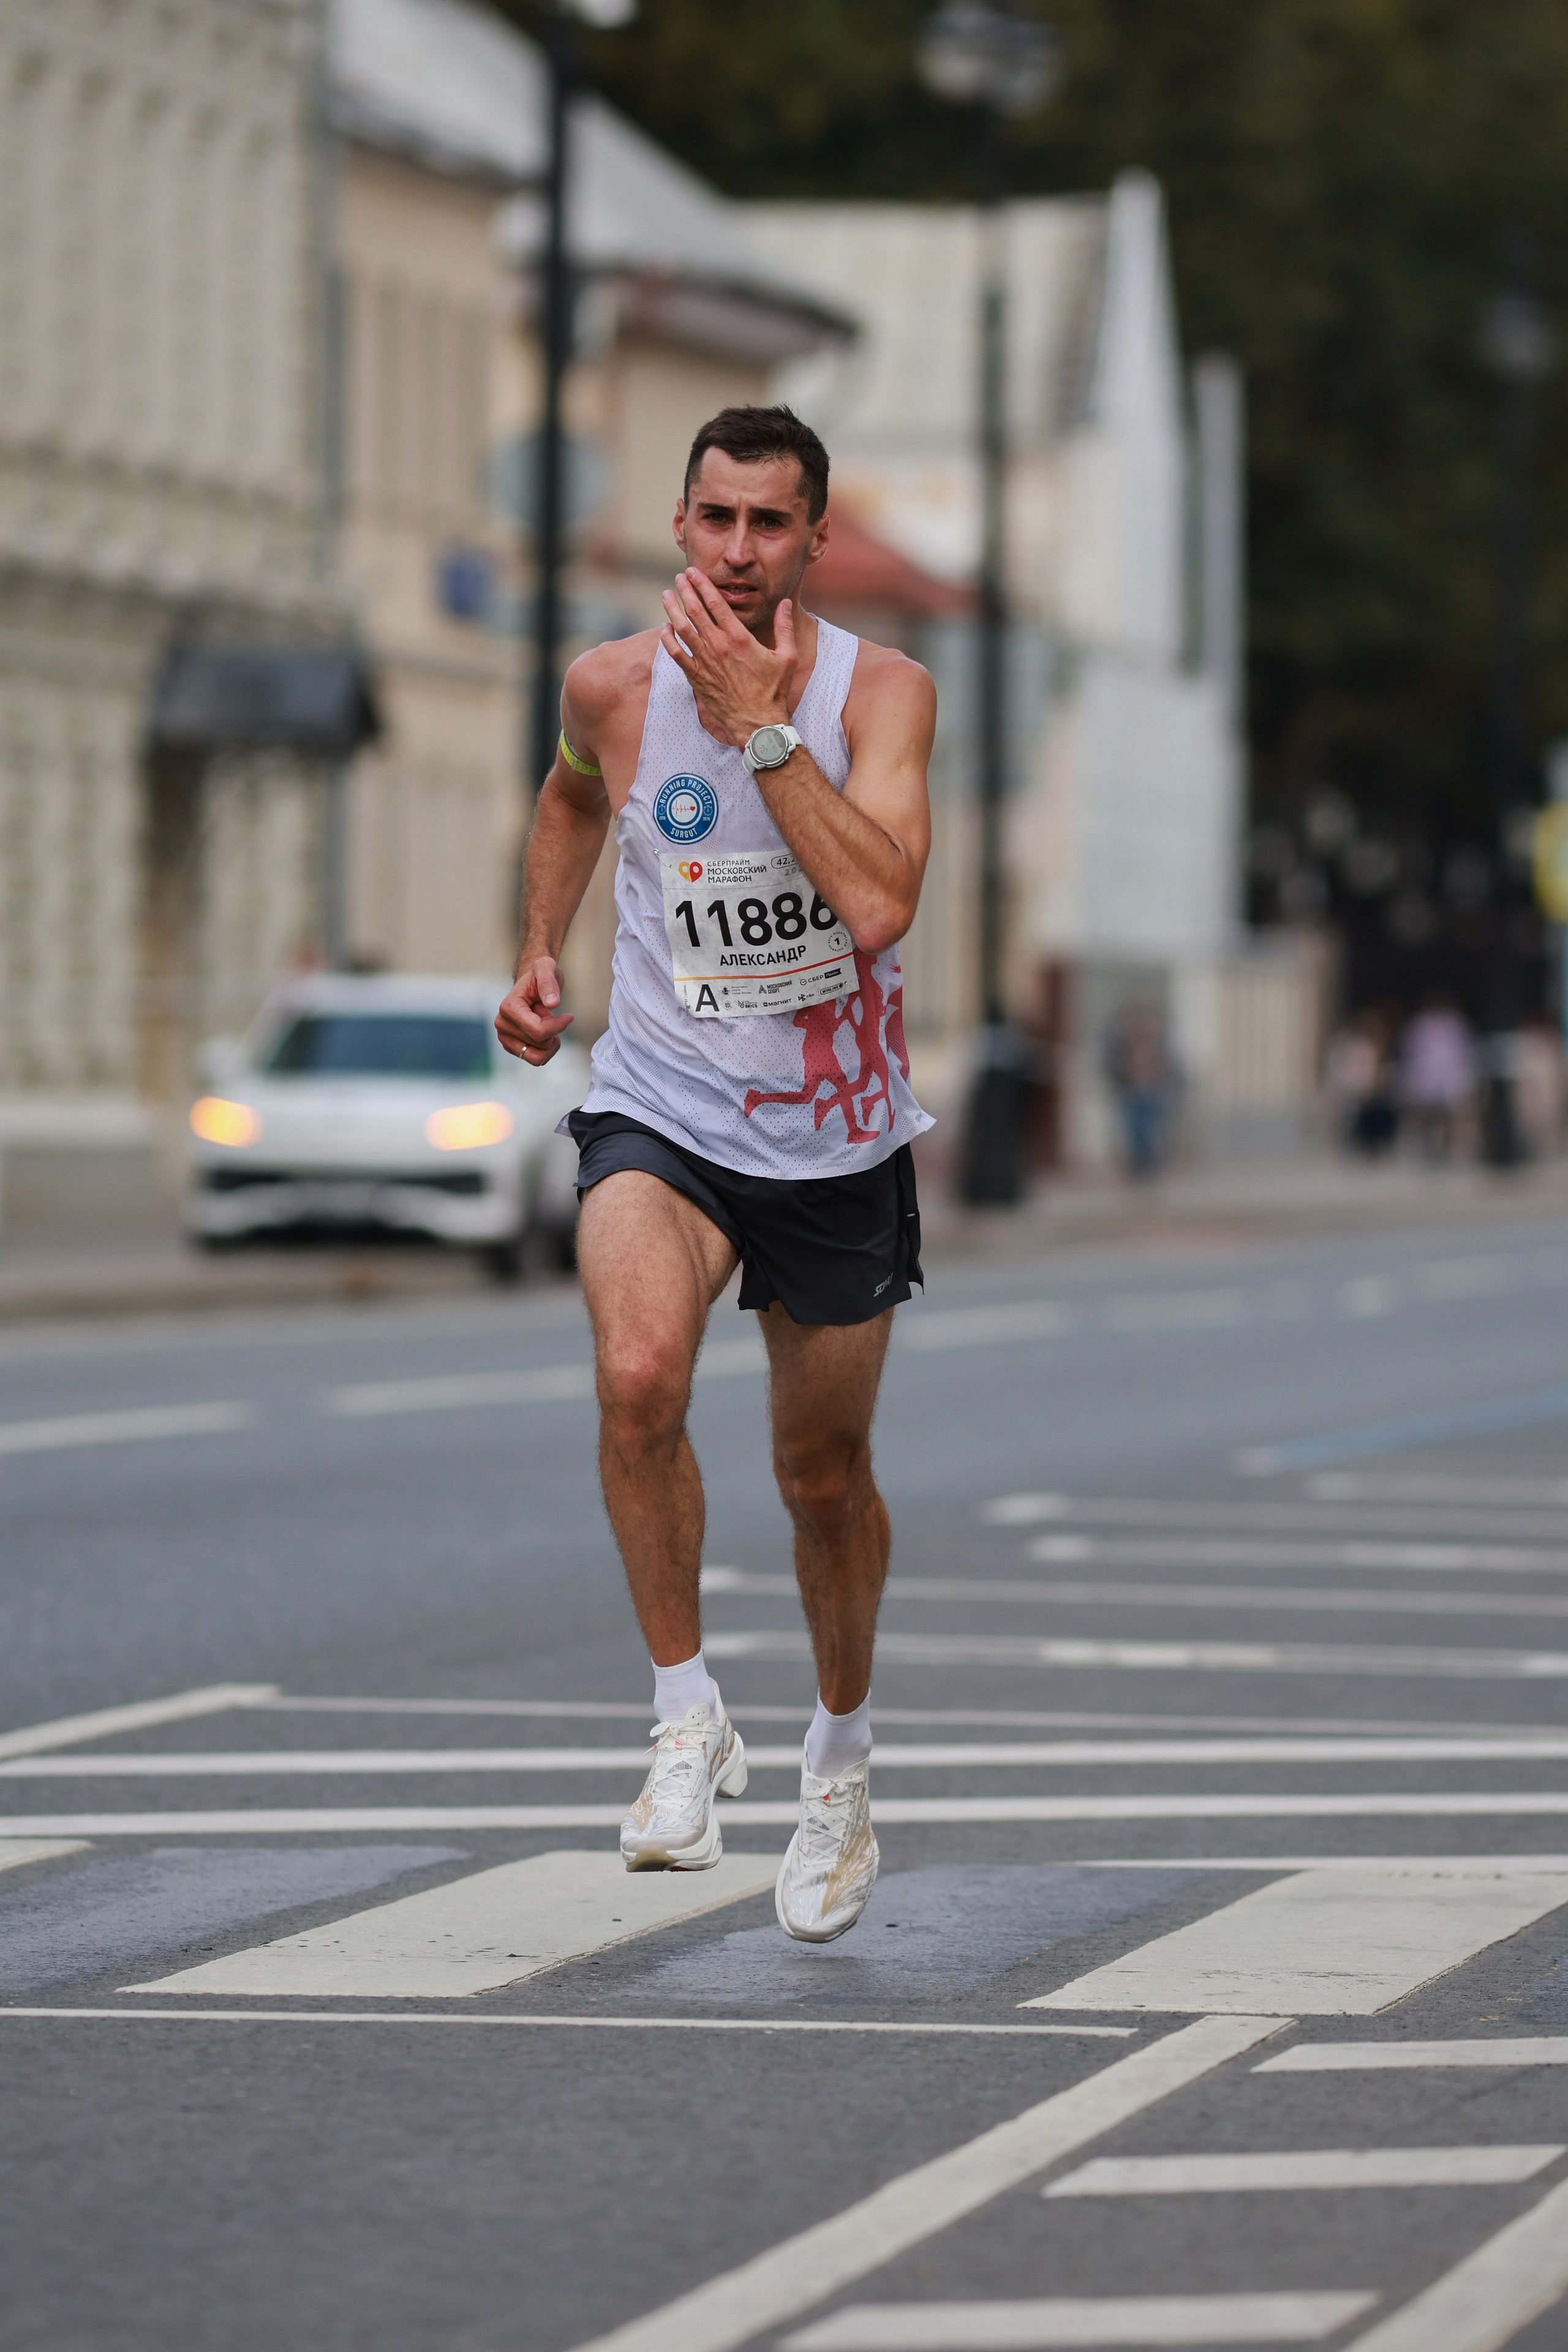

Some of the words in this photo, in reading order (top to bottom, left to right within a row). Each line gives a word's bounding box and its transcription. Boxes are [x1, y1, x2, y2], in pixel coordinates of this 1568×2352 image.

[660, 779, 685, 804] RUNNING
[687, 779, 712, 804] PROJECT
[670, 827, 698, 838] SURGUT
[707, 865, 767, 875] МОСКОВСКИЙ
[676, 891, 839, 947] 11886
[720, 945, 807, 966] АЛЕКСАНДР
[767, 979, 793, 989] МОСКОВСКИЙ
[808, 974, 824, 983] СБЕР
